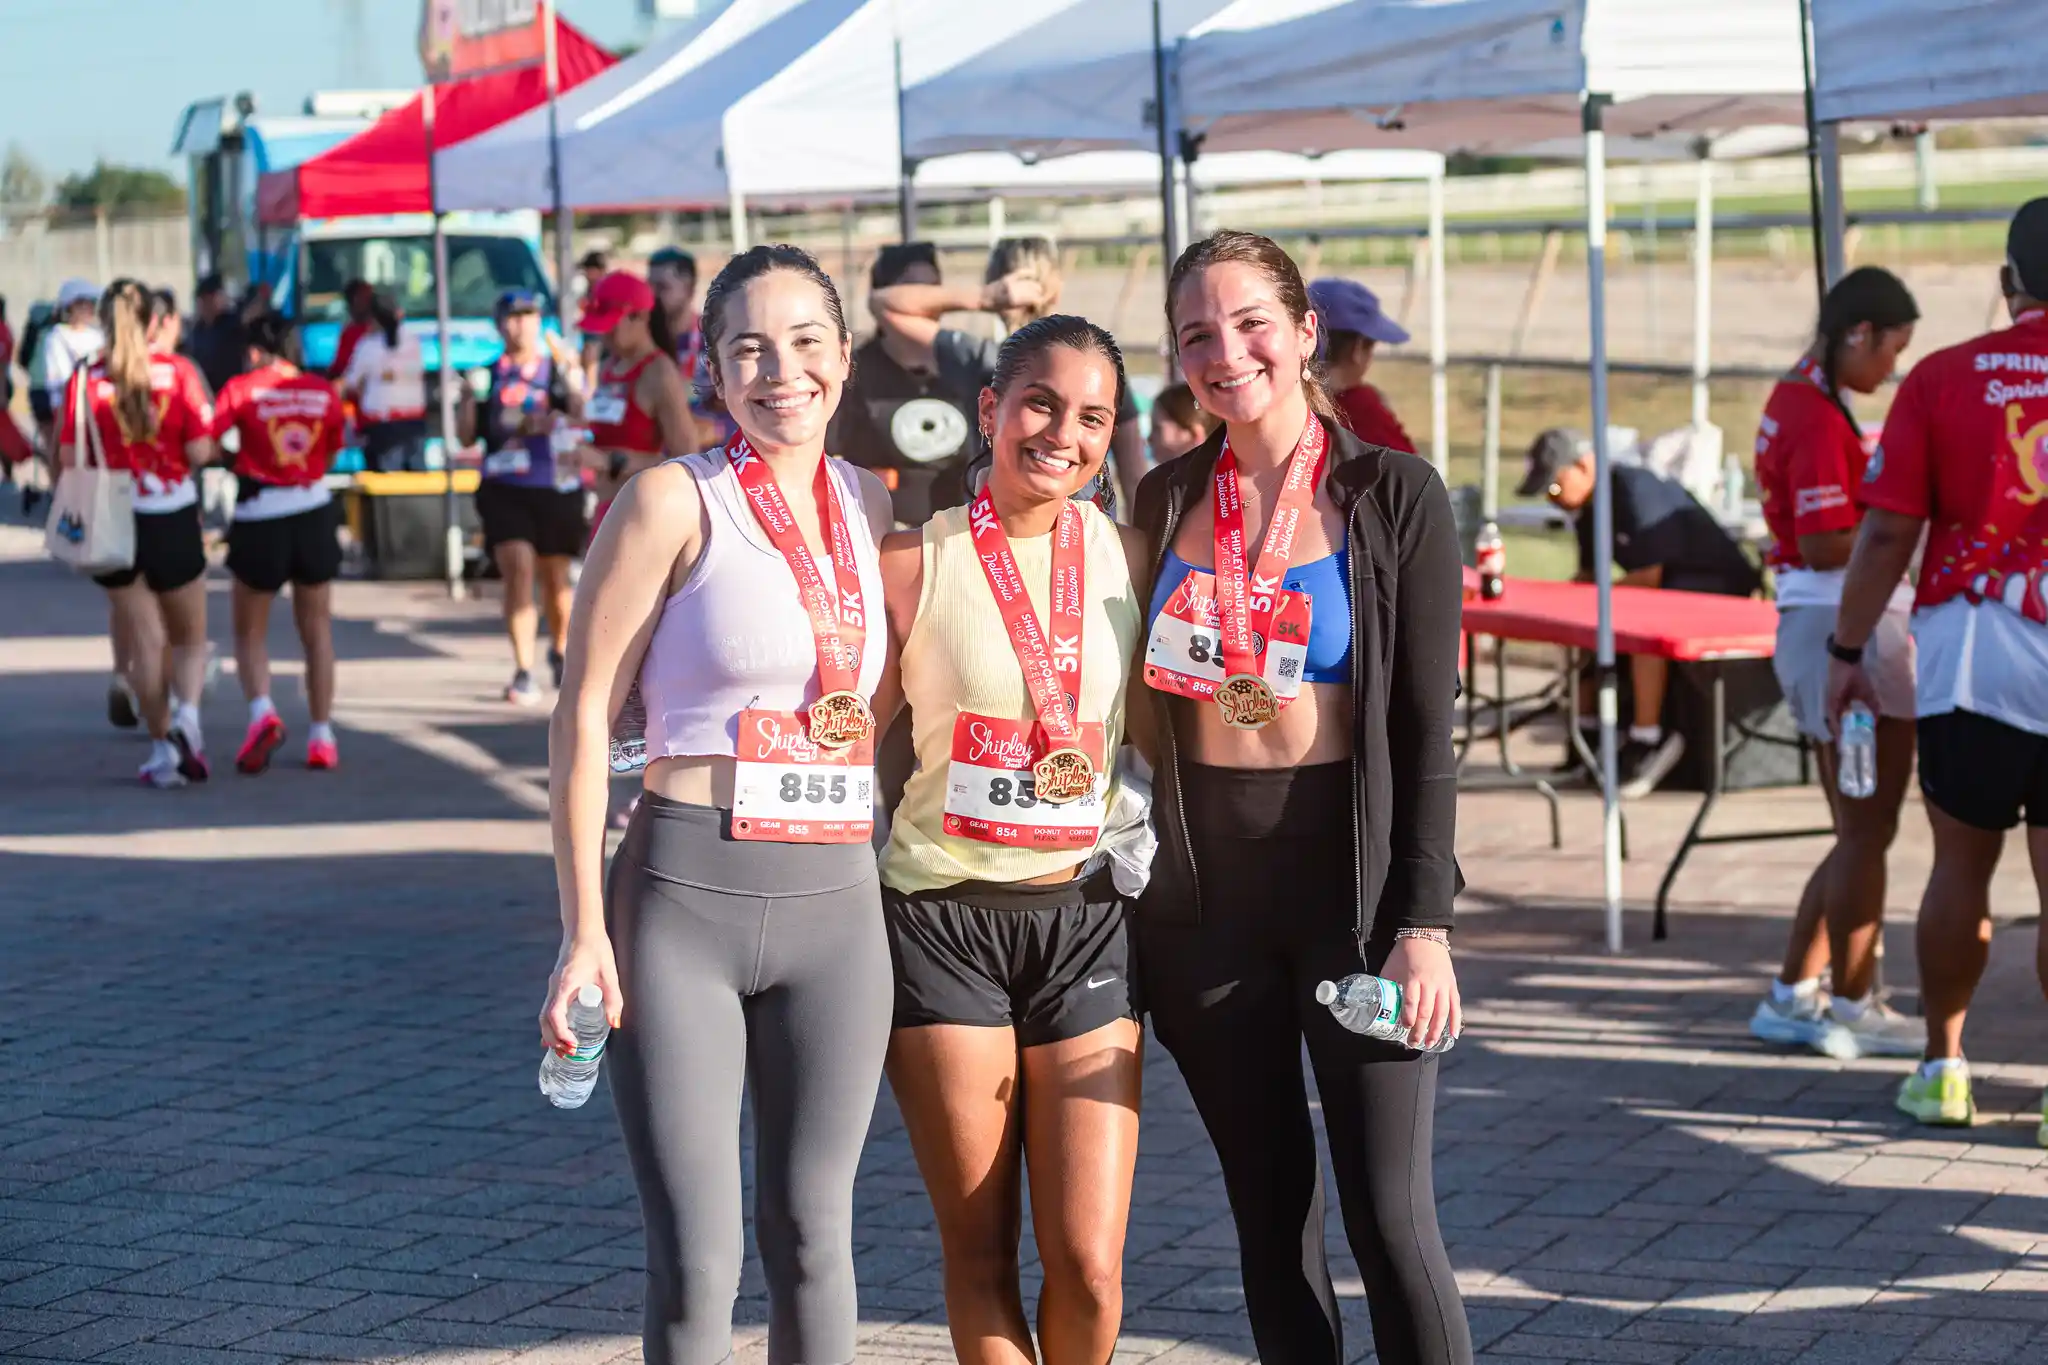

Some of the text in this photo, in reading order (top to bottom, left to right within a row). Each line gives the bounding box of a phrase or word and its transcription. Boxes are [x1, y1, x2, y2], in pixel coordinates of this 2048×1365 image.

[730, 437, 759, 475] 5K
[1288, 446, 1311, 491] SHIPLEY
[1304, 411, 1317, 447] DONU
[1216, 472, 1229, 518] Delicious
[1228, 468, 1238, 511] MAKE LIFE
[1302, 467, 1314, 488] HOT
[746, 485, 785, 534] Delicious
[765, 483, 793, 527] MAKE LIFE
[971, 499, 999, 540] 5K
[1060, 501, 1072, 548] SHIPLEY
[832, 522, 844, 566] MAKE LIFE
[838, 522, 858, 577] Delicious
[1072, 525, 1080, 546] HOT
[1265, 508, 1287, 553] MAKE LIFE
[1274, 508, 1300, 560] Delicious
[982, 552, 1013, 602] Delicious
[1000, 550, 1022, 594] MAKE LIFE
[1055, 568, 1065, 613] MAKE LIFE
[1066, 566, 1082, 618] Delicious
[1220, 538, 1237, 645] HOT GLAZED DONUTS
[1230, 529, 1248, 650] SHIPLEY DONUT DASH
[1250, 572, 1280, 613] 5K
[789, 553, 833, 667] HOT GLAZED DONUTS
[796, 545, 846, 670] SHIPLEY DONUT DASH
[840, 587, 863, 628] 5K
[1174, 577, 1219, 615] Shipl
[1278, 621, 1300, 637] 5K
[1054, 634, 1078, 673] 5K
[1189, 634, 1225, 669] 85
[1013, 622, 1056, 732] HOT GLAZED DONUTS
[1022, 613, 1046, 657] SHIPLEY
[1038, 659, 1062, 701] DONUT
[1054, 704, 1072, 736] DASH
[1168, 672, 1213, 694] GEAR 856
[812, 704, 870, 740] Shipley
[1216, 690, 1276, 724] Shipley
[756, 717, 819, 760] Shipley
[969, 722, 1033, 766] Shipley
[1002, 756, 1022, 764] Donut
[780, 772, 846, 804] 855
[1036, 762, 1094, 797] Shipley
[788, 824, 809, 835] 855
[970, 820, 989, 830] GEAR
[996, 826, 1018, 838] 854
